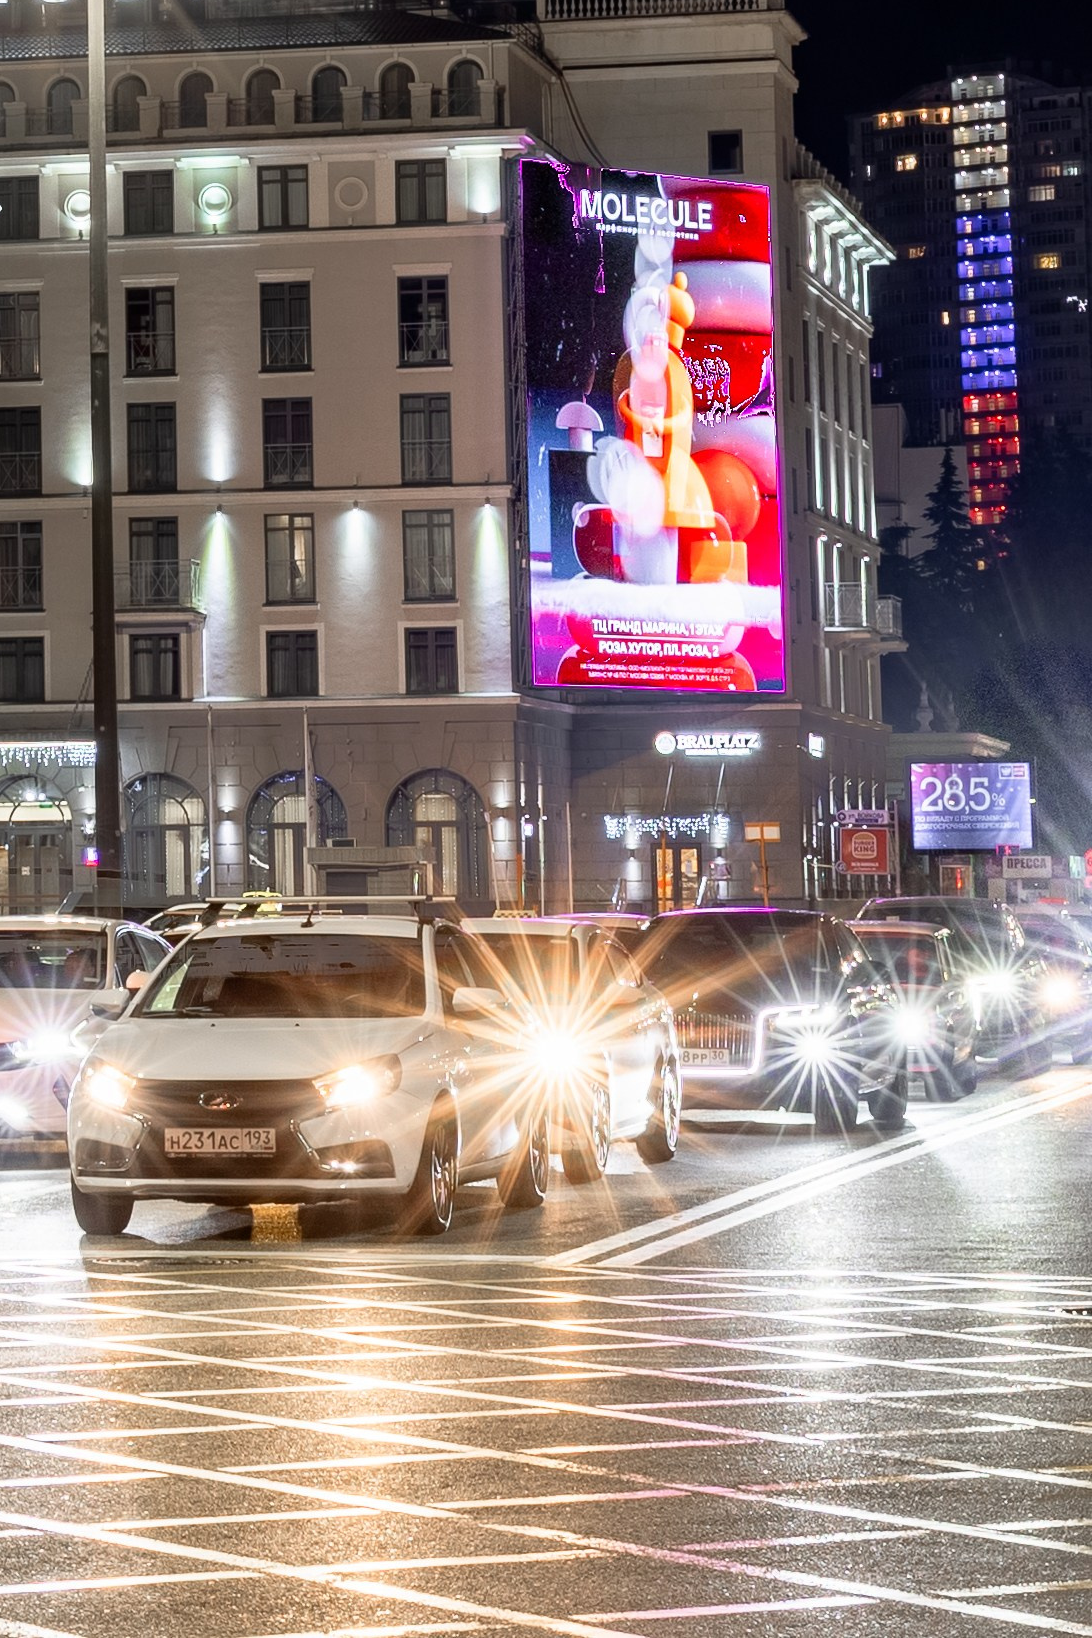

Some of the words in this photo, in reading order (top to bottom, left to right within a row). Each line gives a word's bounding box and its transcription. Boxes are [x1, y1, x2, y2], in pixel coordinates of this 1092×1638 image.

[581, 189, 713, 231] MOLECULE
[592, 619, 607, 634] ТЦ
[608, 620, 642, 635] ГРАНД
[642, 621, 688, 637] МАРИНА,
[694, 624, 724, 637] ЭТАЖ
[599, 641, 628, 654] РОЗА
[628, 642, 663, 657] ХУТОР,
[681, 644, 712, 658] РОЗА,
[712, 645, 719, 658] 2
[1006, 857, 1047, 869] ПРЕССА
[681, 1050, 708, 1064] 8РР
[711, 1050, 725, 1060] 30
[170, 1131, 240, 1150] Н231АС
[244, 1130, 271, 1145] 193
